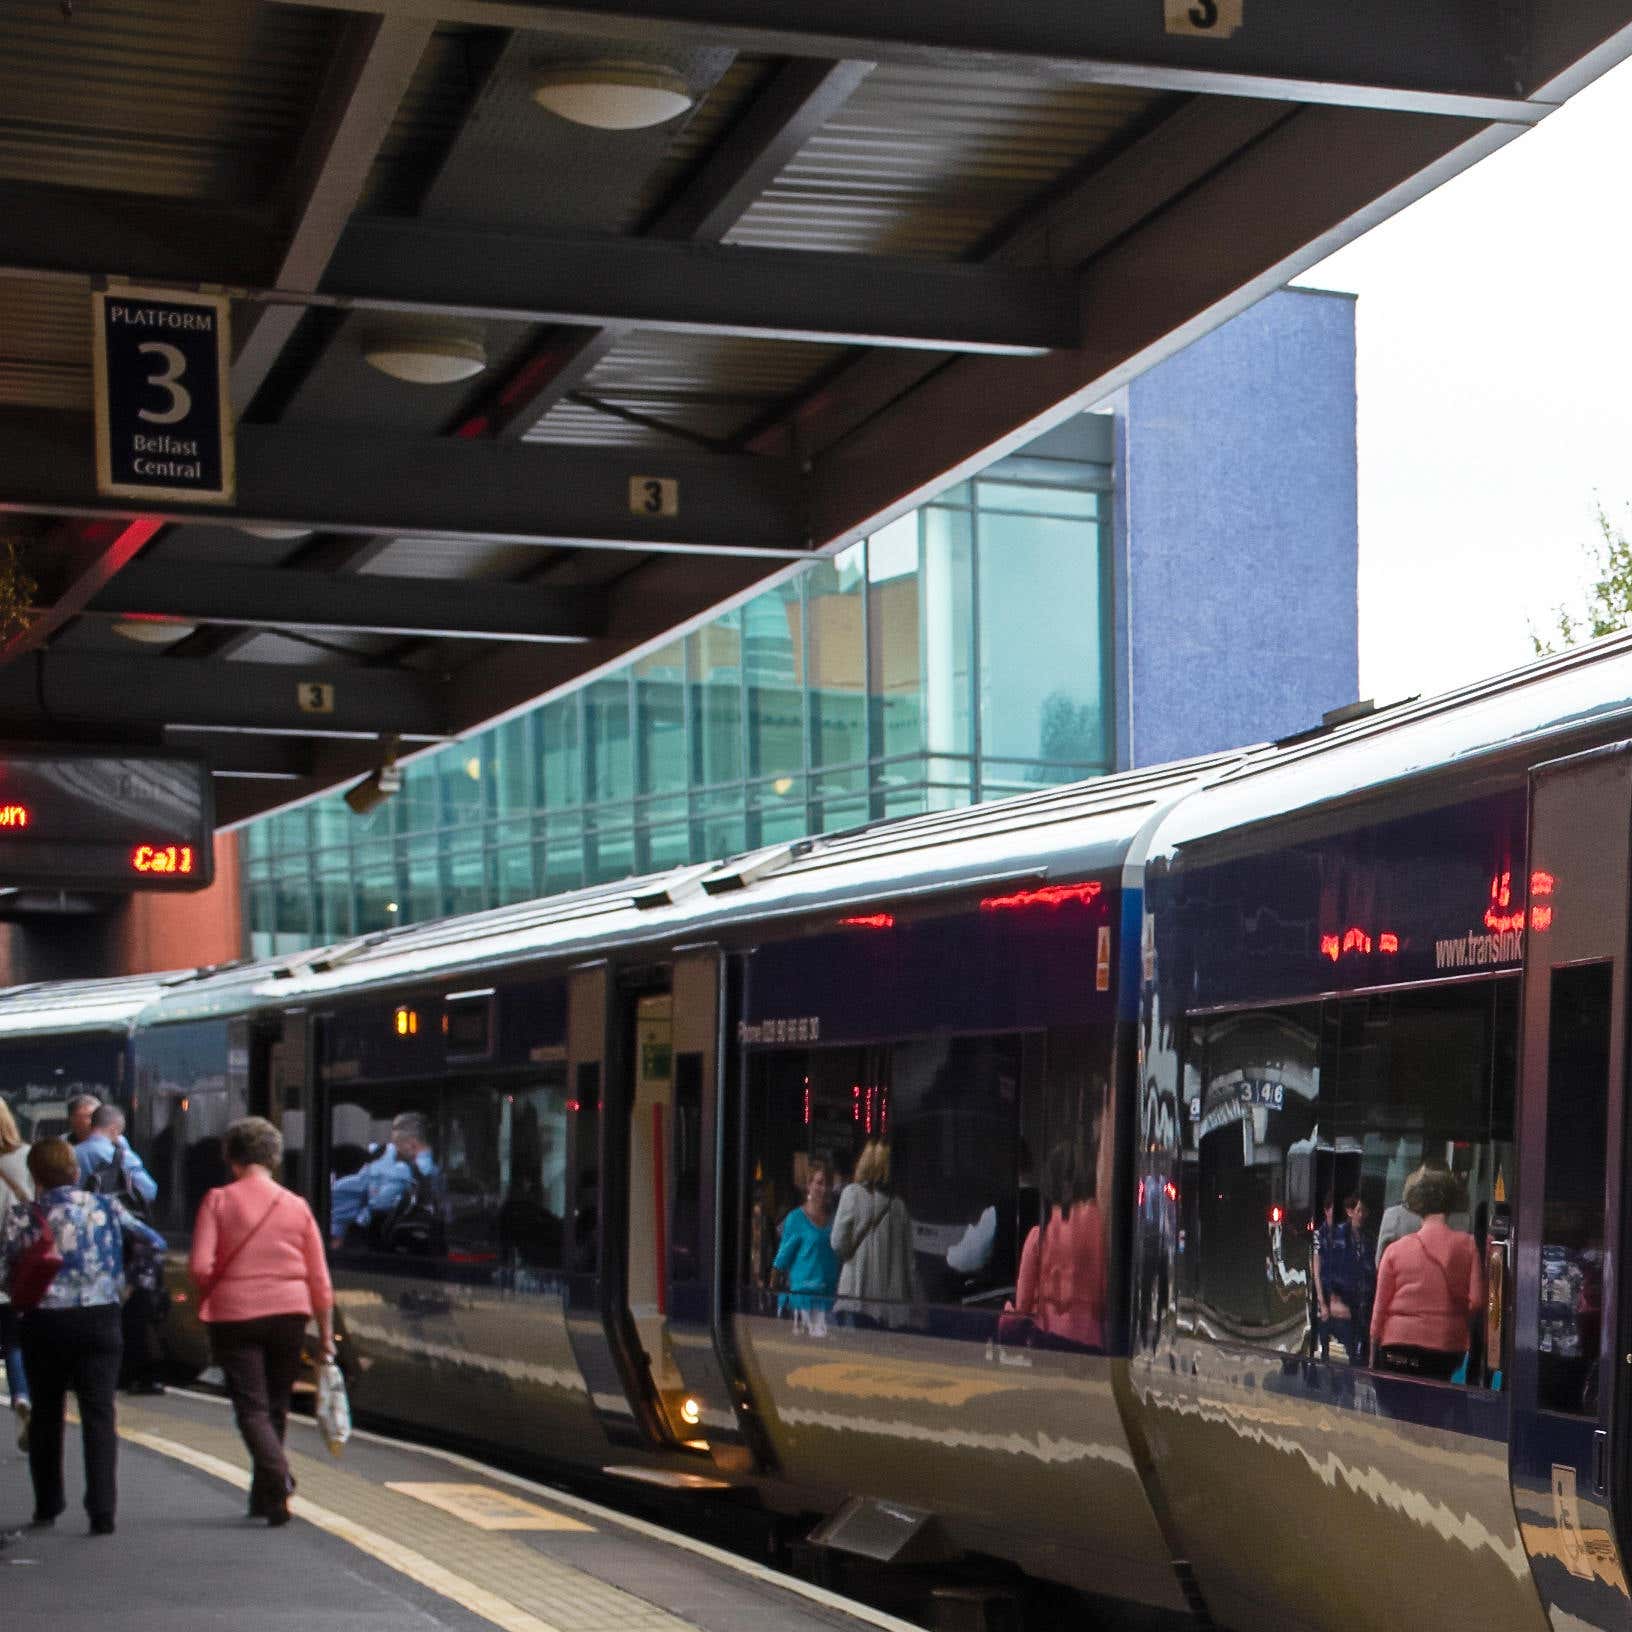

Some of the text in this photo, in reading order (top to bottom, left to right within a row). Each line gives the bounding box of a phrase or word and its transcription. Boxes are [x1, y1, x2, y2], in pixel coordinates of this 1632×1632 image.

[111, 306, 213, 331] PLATFORM
[138, 341, 193, 424] 3
[133, 434, 199, 456] Belfast
[133, 457, 201, 479] Central
[644, 480, 663, 513] 3
[309, 686, 324, 709] 3
[132, 845, 193, 874] Call
